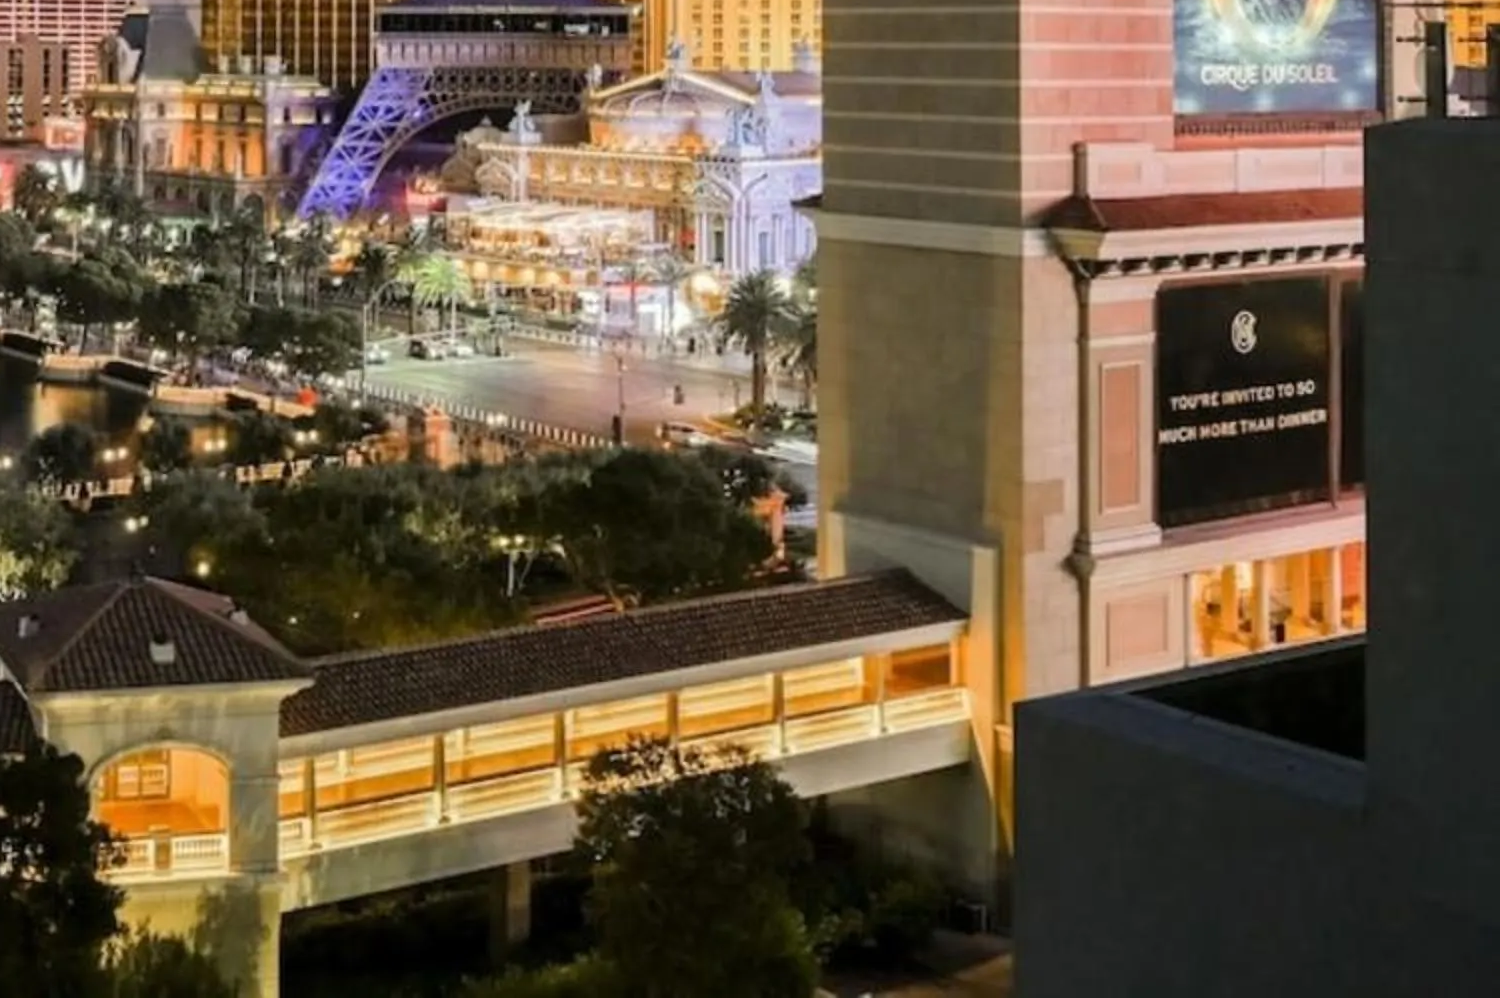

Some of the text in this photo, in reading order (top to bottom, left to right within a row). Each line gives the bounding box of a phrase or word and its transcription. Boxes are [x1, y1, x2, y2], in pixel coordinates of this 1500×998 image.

[1201, 63, 1259, 91] CIRQUE
[1262, 63, 1285, 85] DU
[1170, 379, 1316, 412] YOU'RE INVITED TO SO
[1158, 408, 1328, 445] MUCH MORE THAN DINNER
